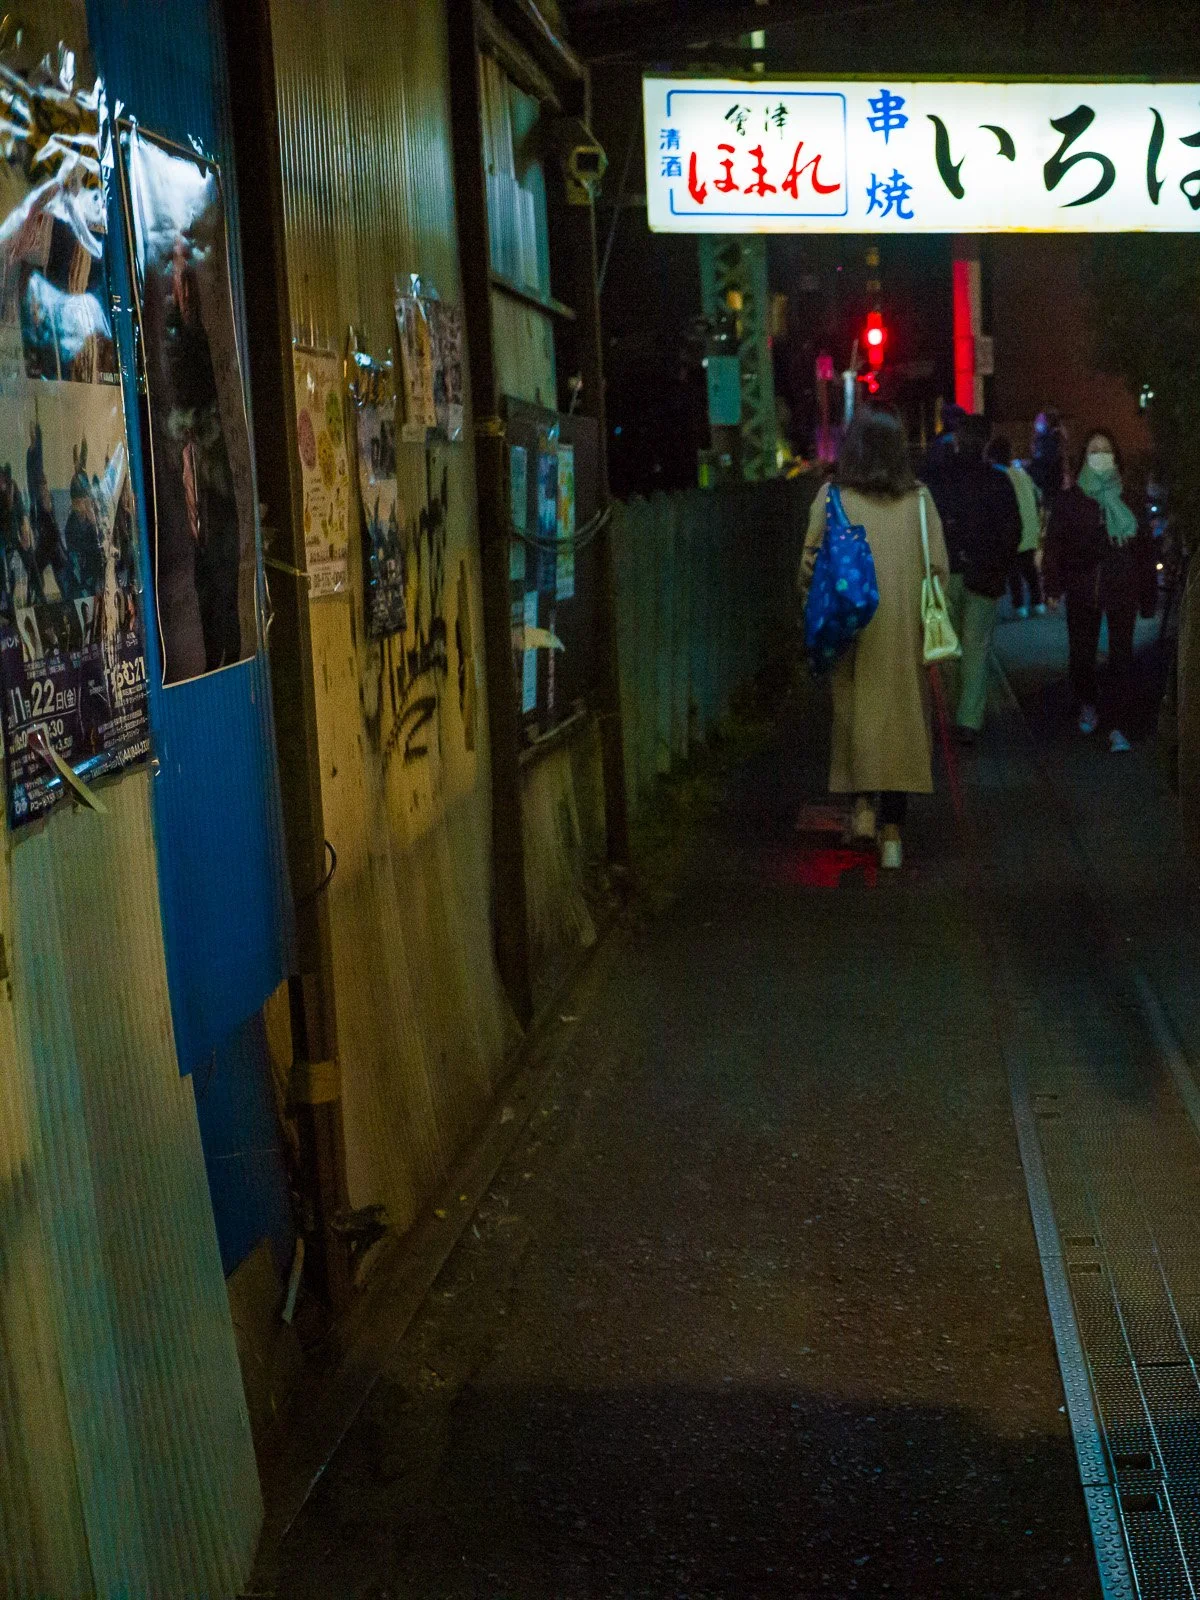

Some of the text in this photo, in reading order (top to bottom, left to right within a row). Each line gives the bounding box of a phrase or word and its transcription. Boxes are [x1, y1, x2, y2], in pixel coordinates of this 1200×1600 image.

[659, 129, 681, 178] 清酒
[687, 141, 841, 203] ほまれ
[865, 89, 914, 219] 串焼
